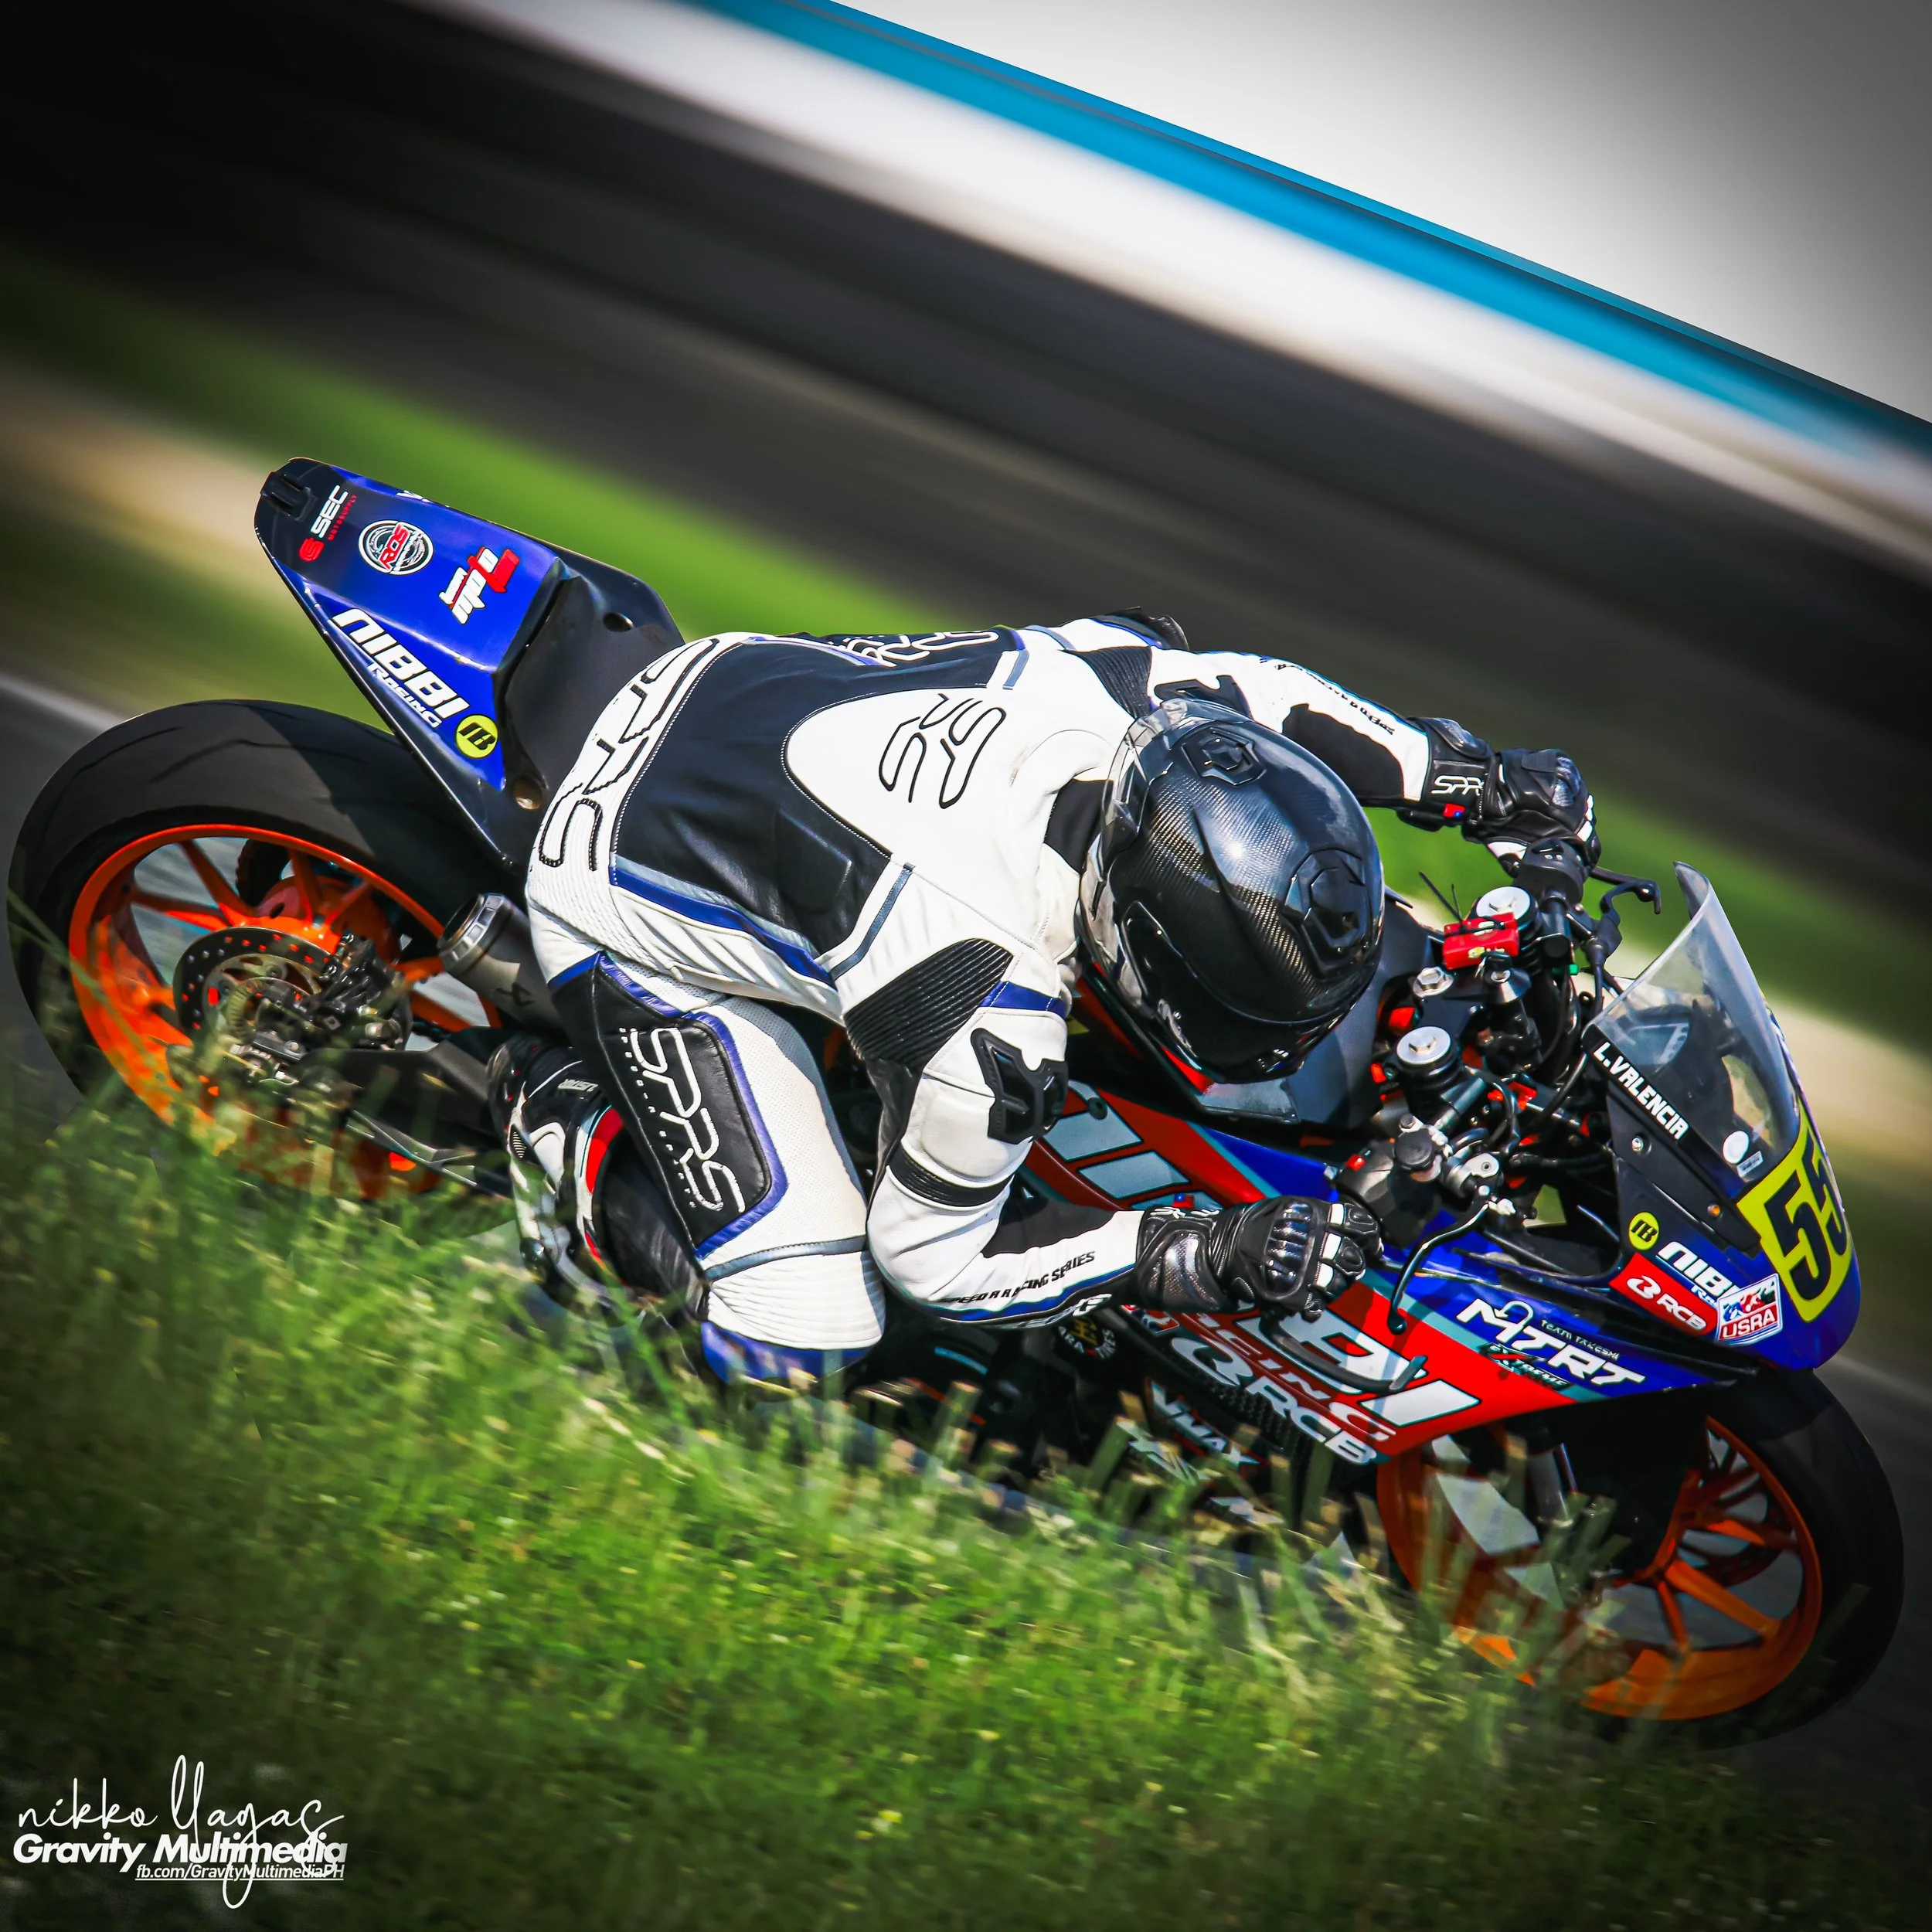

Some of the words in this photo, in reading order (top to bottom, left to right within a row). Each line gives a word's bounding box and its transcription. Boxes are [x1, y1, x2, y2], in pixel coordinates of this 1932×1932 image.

[311, 485, 348, 539] SEC
[331, 608, 470, 720] NIBBI
[1594, 1042, 1689, 1141] L.VALENCIA
[1764, 1132, 1849, 1301] 55
[1656, 1292, 1707, 1332] RCB
[1722, 1308, 1776, 1338] USRA
